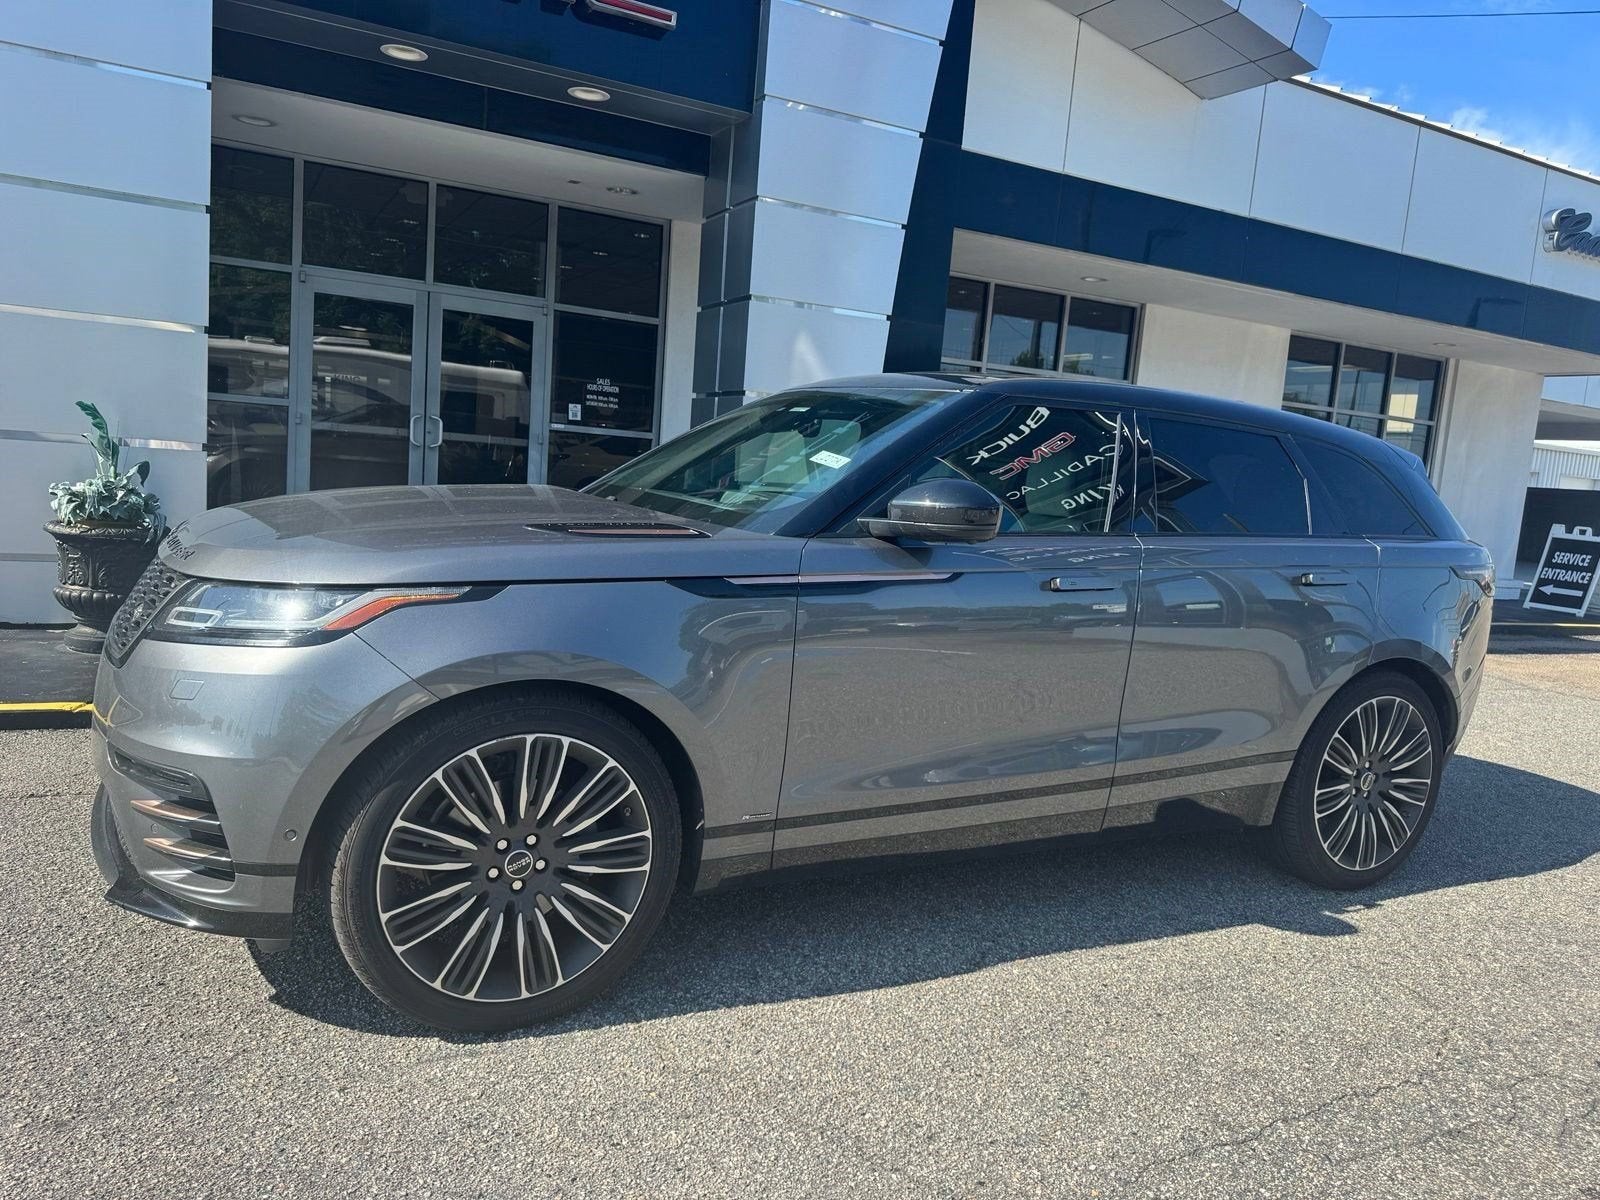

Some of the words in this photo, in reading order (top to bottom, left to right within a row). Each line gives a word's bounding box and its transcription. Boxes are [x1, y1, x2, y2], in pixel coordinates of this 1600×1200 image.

[597, 377, 610, 386] SALES
[1552, 551, 1592, 567] SERVICE
[1540, 567, 1592, 584] ENTRANCE
